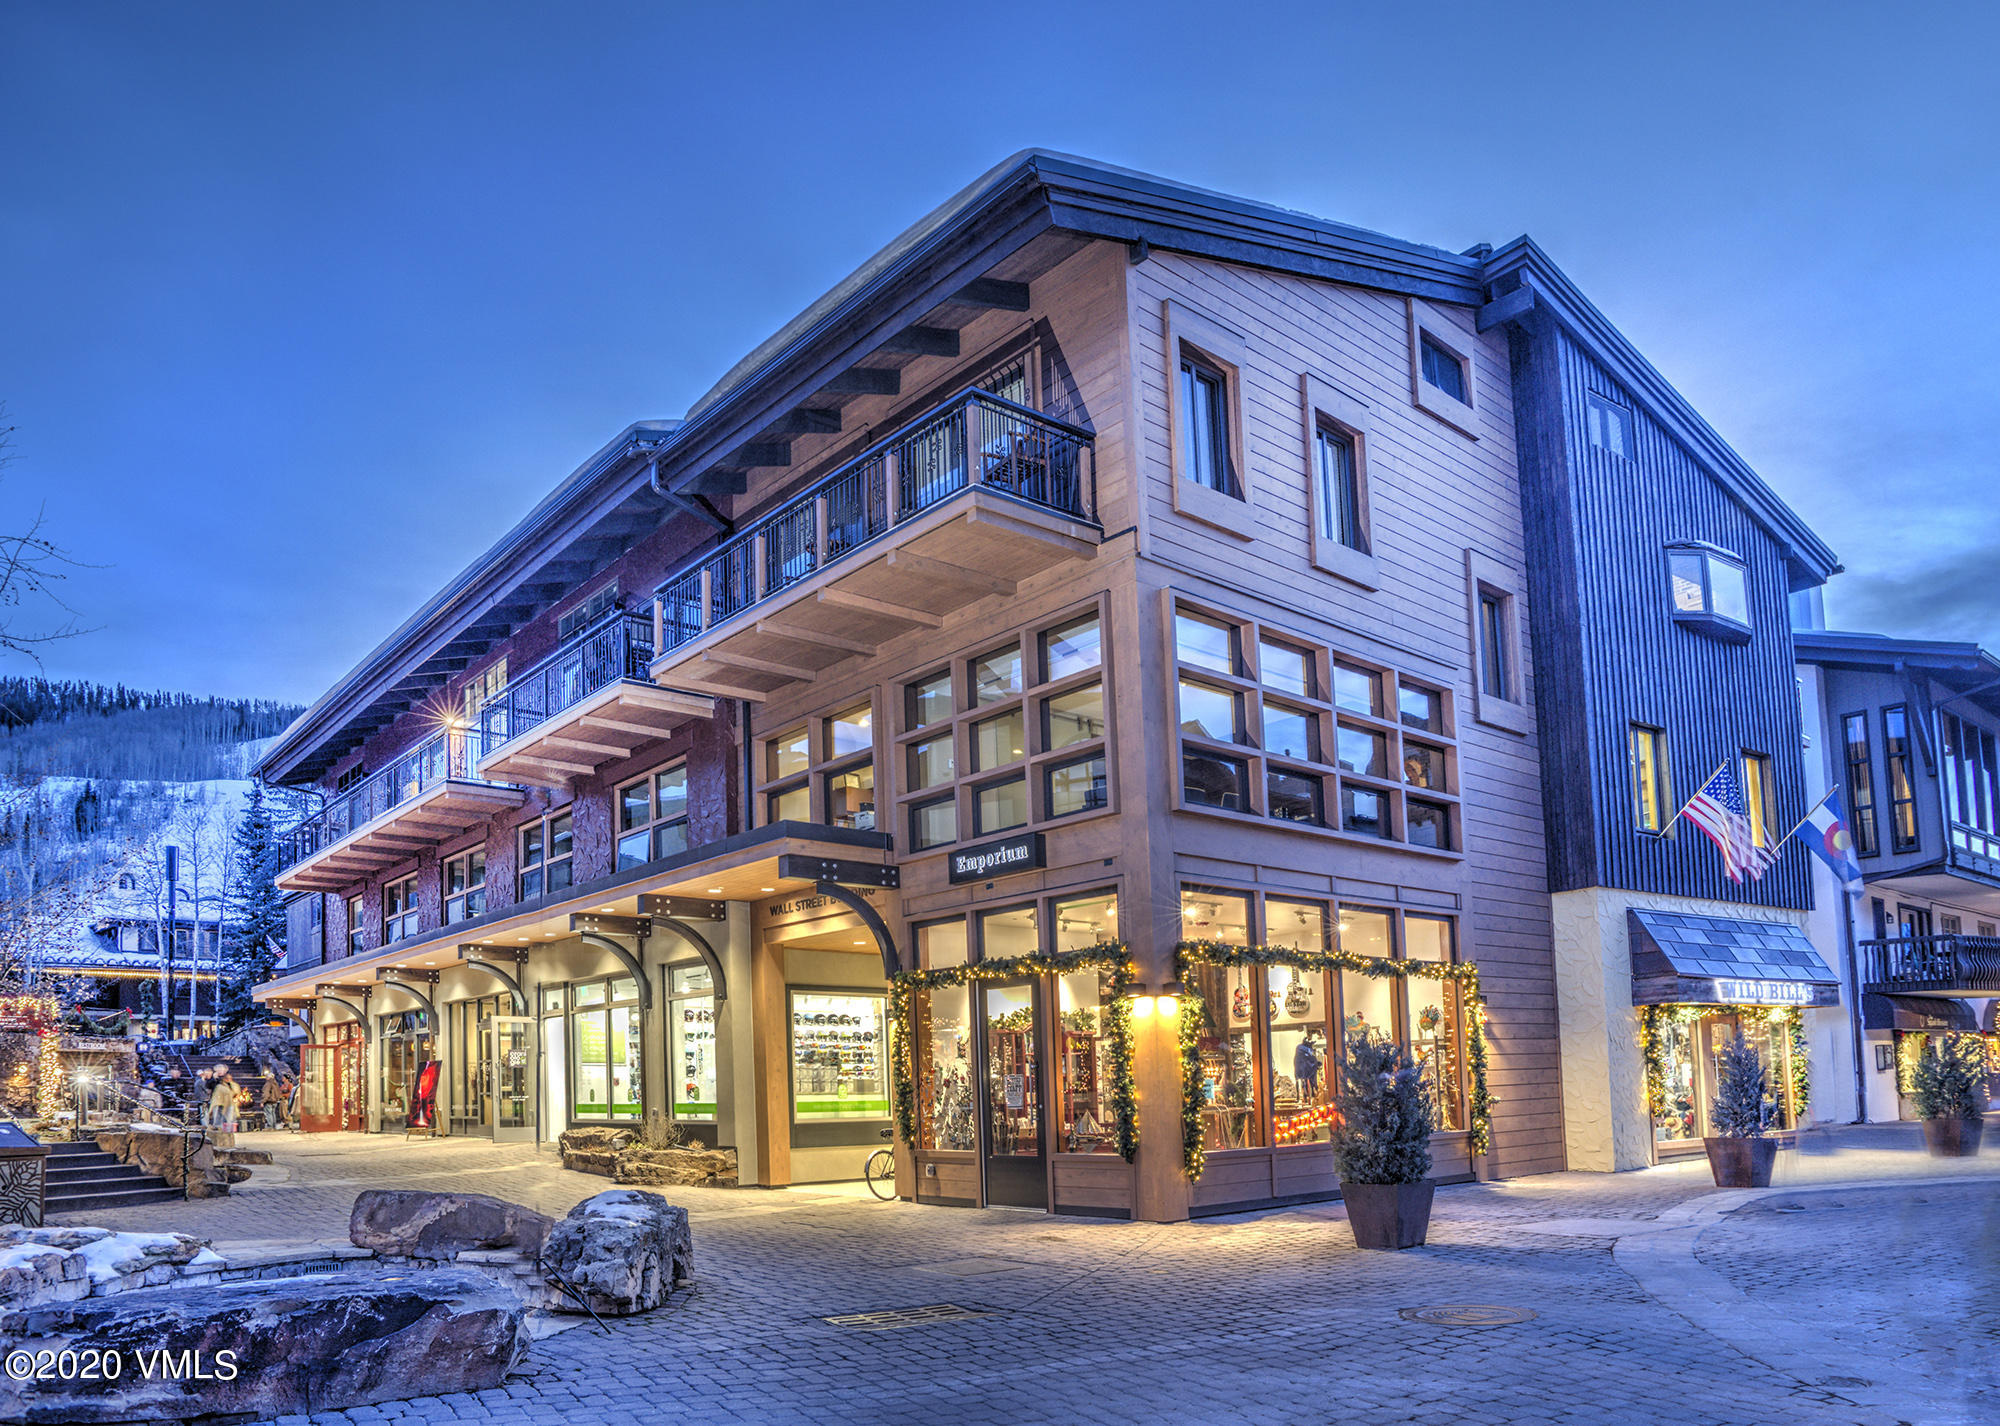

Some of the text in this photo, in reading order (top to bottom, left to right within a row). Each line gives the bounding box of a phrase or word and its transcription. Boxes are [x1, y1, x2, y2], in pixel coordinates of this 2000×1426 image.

[956, 845, 1029, 874] Emporium
[769, 902, 794, 916] WALL
[795, 895, 827, 911] STREET
[1719, 981, 1764, 1000] WILD
